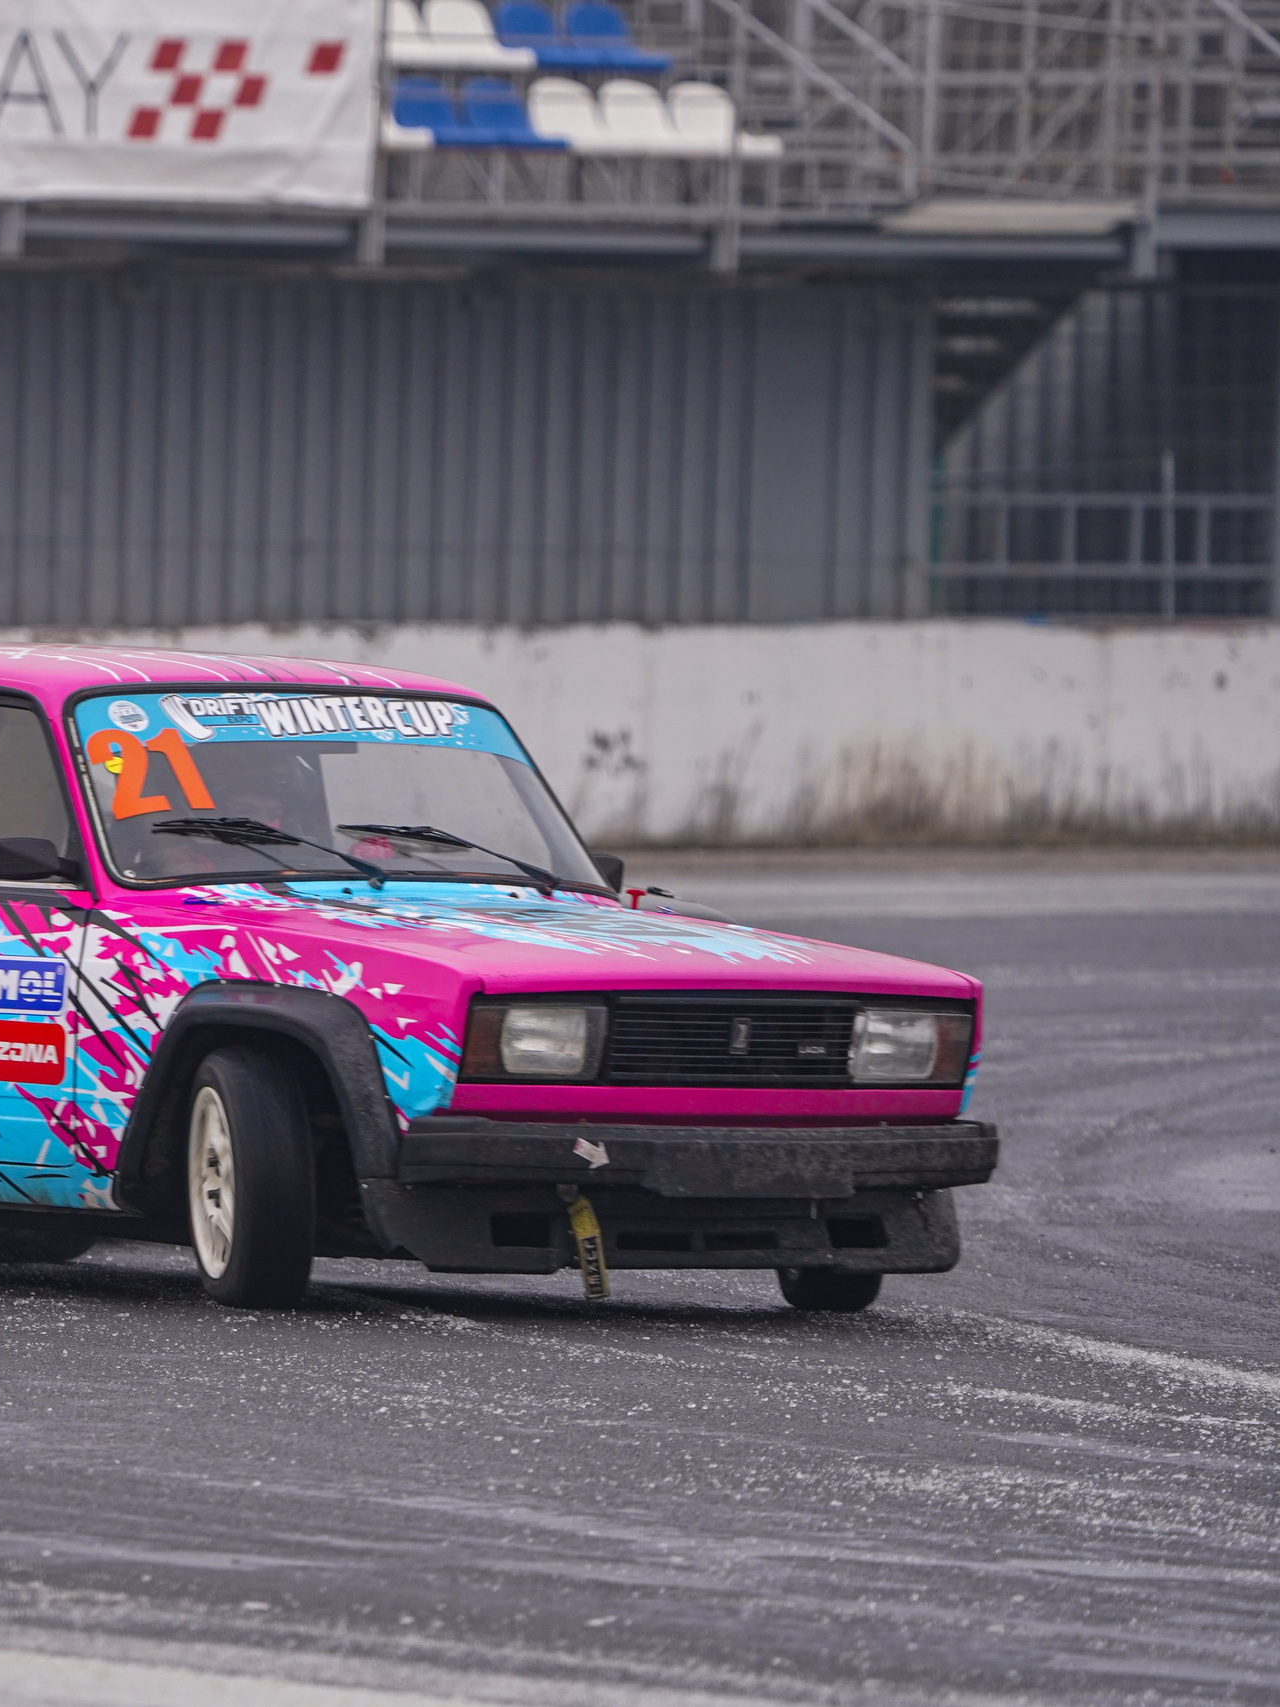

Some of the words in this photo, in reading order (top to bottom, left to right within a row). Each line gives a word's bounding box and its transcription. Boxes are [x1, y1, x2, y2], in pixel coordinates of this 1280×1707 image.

[188, 698, 257, 715] DRIFT
[227, 715, 254, 724] EXPO
[87, 728, 217, 820] 21
